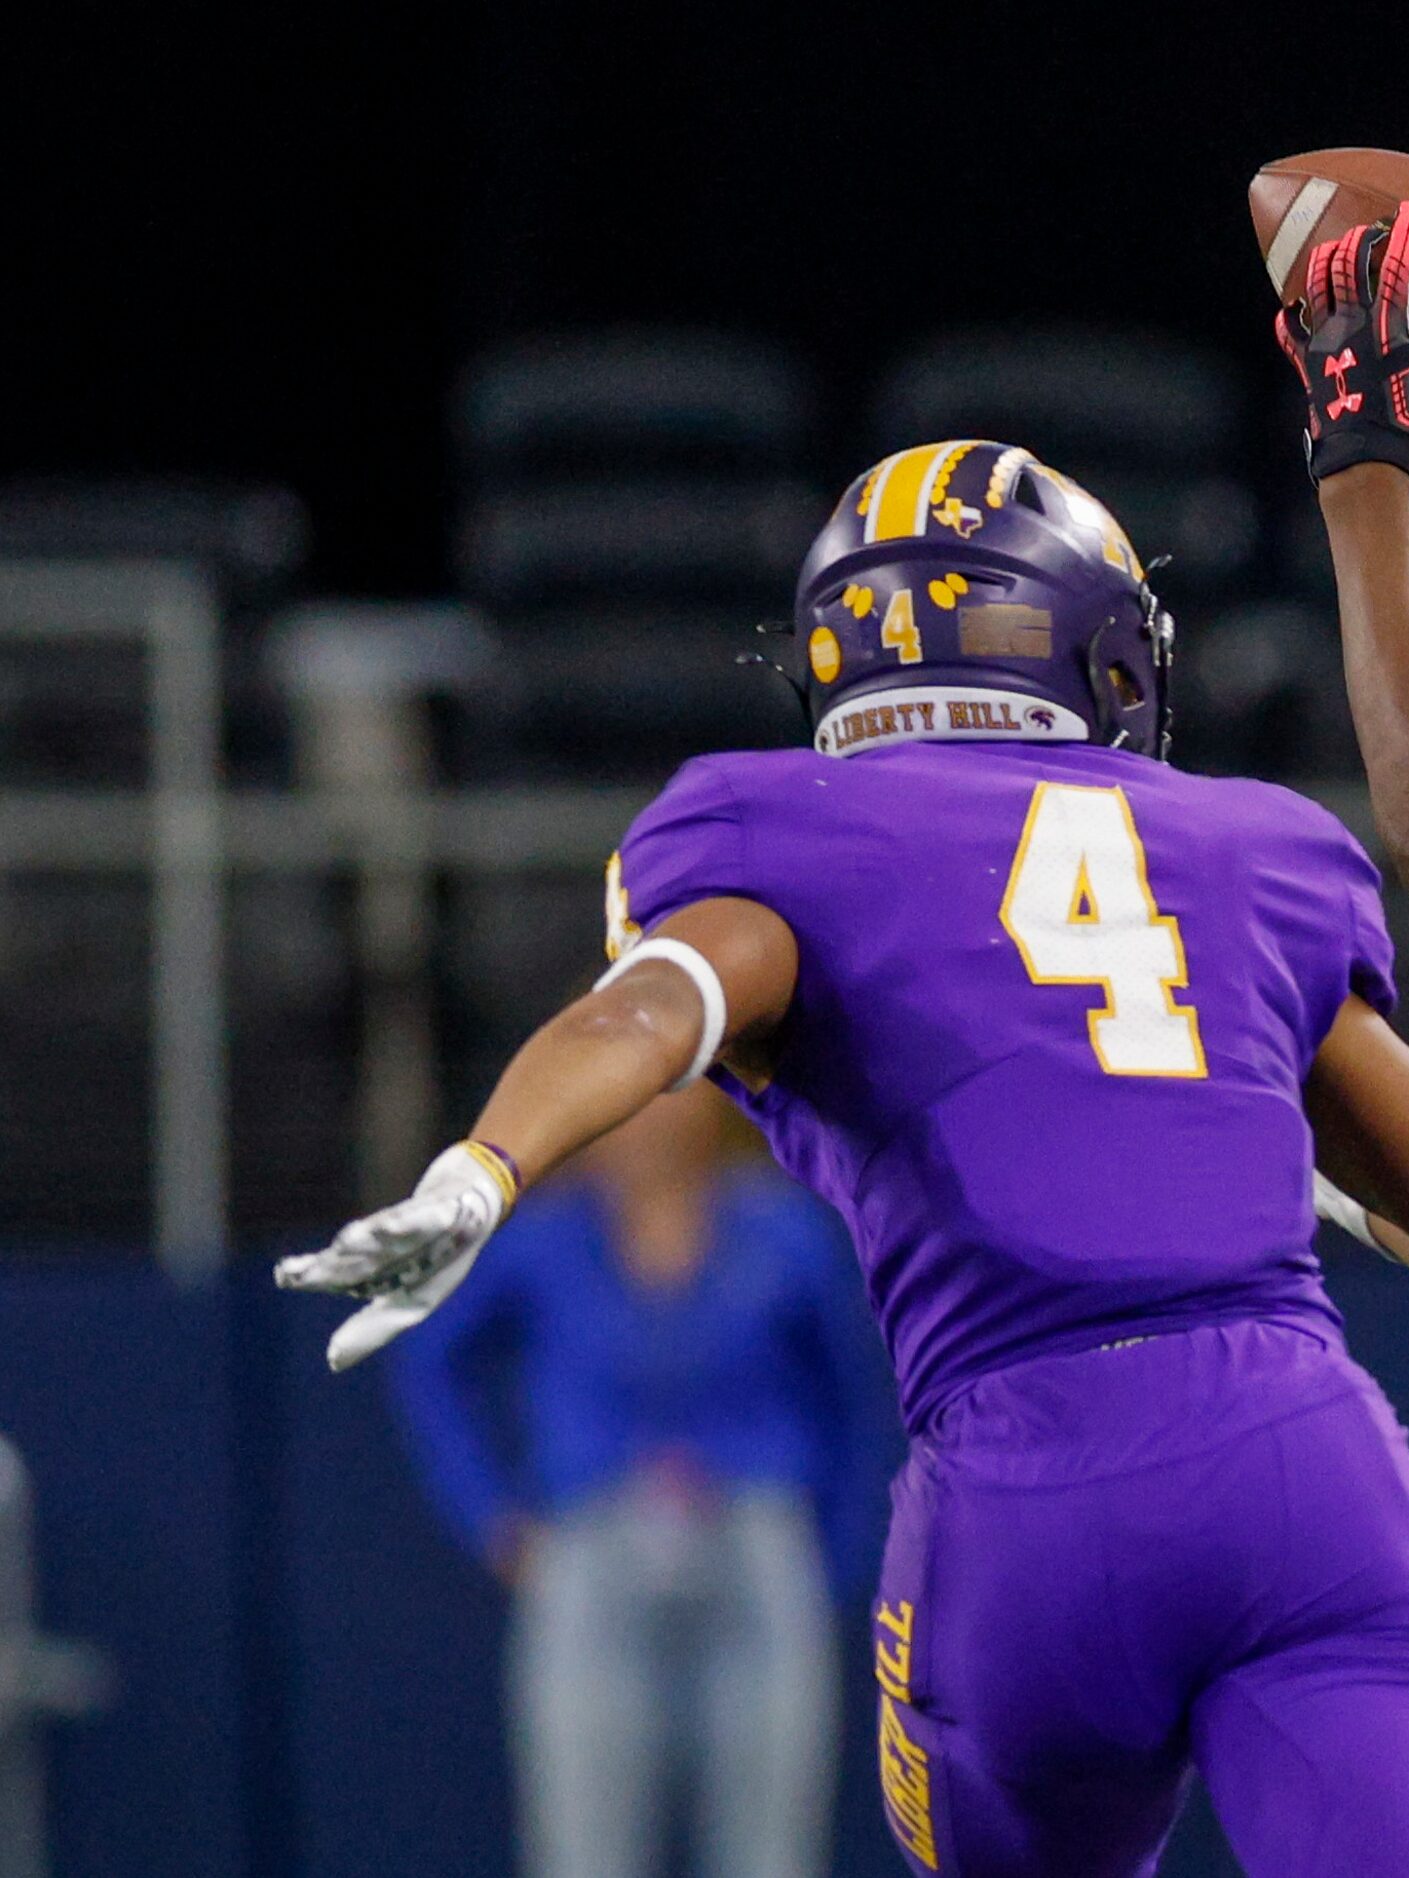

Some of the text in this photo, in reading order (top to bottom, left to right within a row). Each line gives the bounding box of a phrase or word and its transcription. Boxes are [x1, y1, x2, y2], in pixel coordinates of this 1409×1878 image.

[881, 588, 924, 665] 4
[832, 700, 1022, 750] LIBERTY HILL
[999, 780, 1208, 1078] 4
